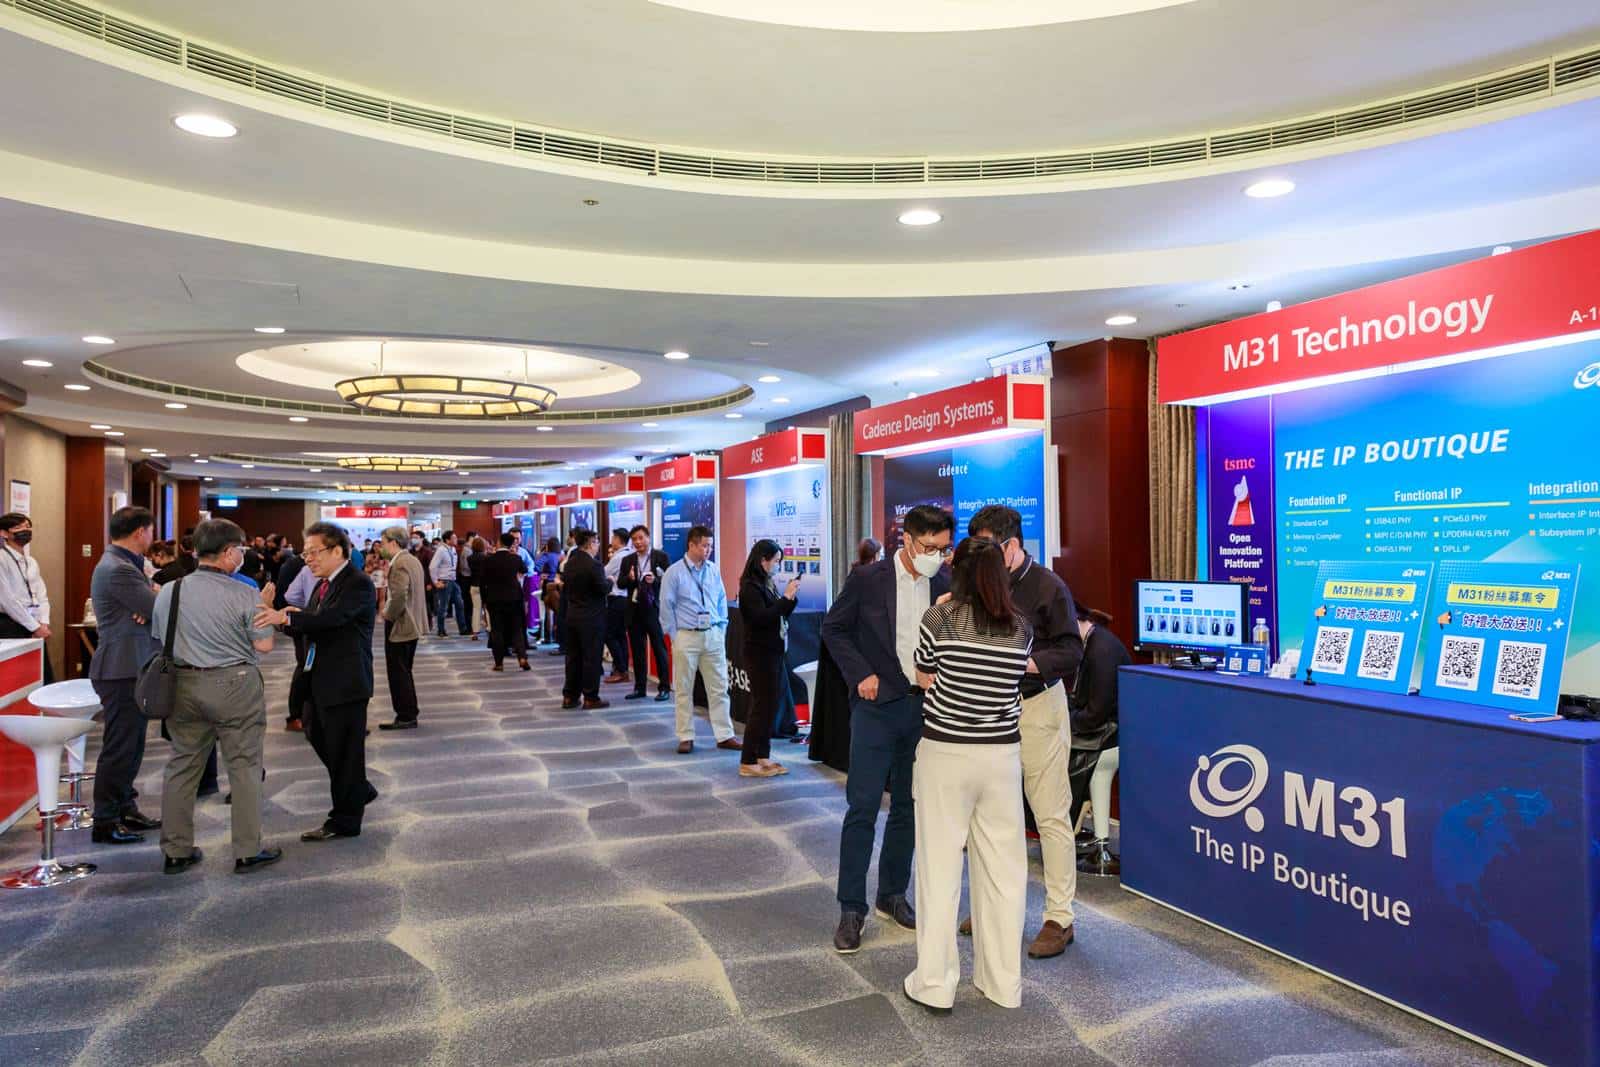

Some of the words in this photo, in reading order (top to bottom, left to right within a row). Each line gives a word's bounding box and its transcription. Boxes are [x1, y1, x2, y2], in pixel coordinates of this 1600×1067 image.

[1569, 305, 1600, 325] A-1
[1223, 334, 1279, 372] M31
[1292, 294, 1494, 358] Technology
[862, 419, 902, 440] Cadence
[904, 409, 941, 433] Design
[943, 399, 994, 428] Systems
[751, 447, 763, 464] ASE
[1284, 448, 1325, 471] THE
[1333, 445, 1356, 466] IP
[1364, 428, 1510, 464] BOUTIQUE
[1224, 457, 1256, 471] tsmc
[1394, 487, 1448, 502] Functional
[1451, 487, 1463, 499] IP
[1528, 480, 1599, 497] Integration
[1289, 495, 1336, 507] Foundation
[1338, 493, 1348, 504] IP
[1539, 511, 1576, 519] Interface
[1578, 509, 1587, 518] IP
[1589, 507, 1600, 518] Int
[1229, 533, 1251, 544] Open
[1413, 531, 1428, 539] PHY
[1539, 527, 1585, 538] Subsystem
[1587, 527, 1596, 536] IP
[1219, 545, 1263, 556] Innovation
[735, 667, 751, 693] ASE
[1283, 770, 1407, 859] M31
[1190, 825, 1234, 865] The
[1242, 841, 1265, 873] IP
[1273, 852, 1412, 926] Boutique
